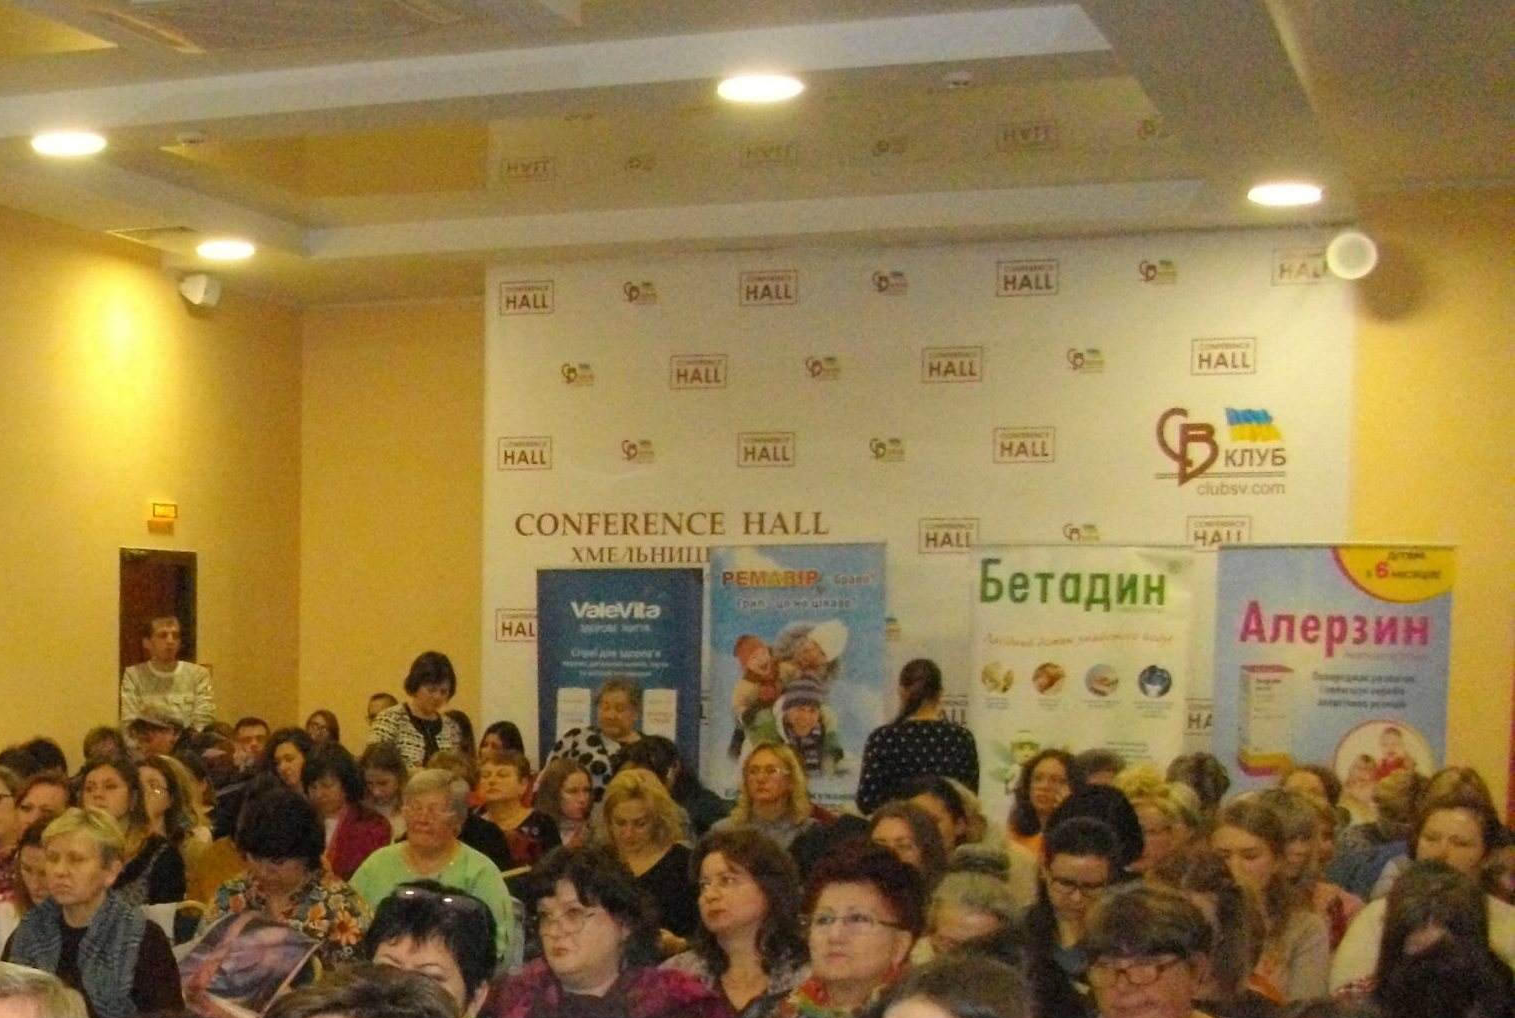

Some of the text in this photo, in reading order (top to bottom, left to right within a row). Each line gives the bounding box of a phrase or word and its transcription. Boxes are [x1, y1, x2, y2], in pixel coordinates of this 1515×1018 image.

[1002, 275, 1053, 291] HALL
[745, 284, 793, 301] HALL
[505, 294, 549, 309] HALL
[928, 360, 977, 377] HALL
[1198, 353, 1251, 369] HALL
[676, 368, 722, 383] HALL
[503, 450, 547, 465] HALL
[743, 445, 790, 462] HALL
[1000, 441, 1049, 457] HALL
[1224, 447, 1287, 468] КЛУБ
[1197, 482, 1286, 497] clubsv.com
[515, 510, 830, 537] CONFERENCE HALL
[925, 532, 973, 548] HALL
[722, 570, 819, 587] РЕМАВІР
[1374, 561, 1391, 580] 6
[979, 558, 1166, 613] Бетадин
[570, 600, 662, 620] ValeVita
[501, 621, 536, 637] HAL
[1238, 599, 1430, 659] Алерзин
[1187, 713, 1213, 730] HA
